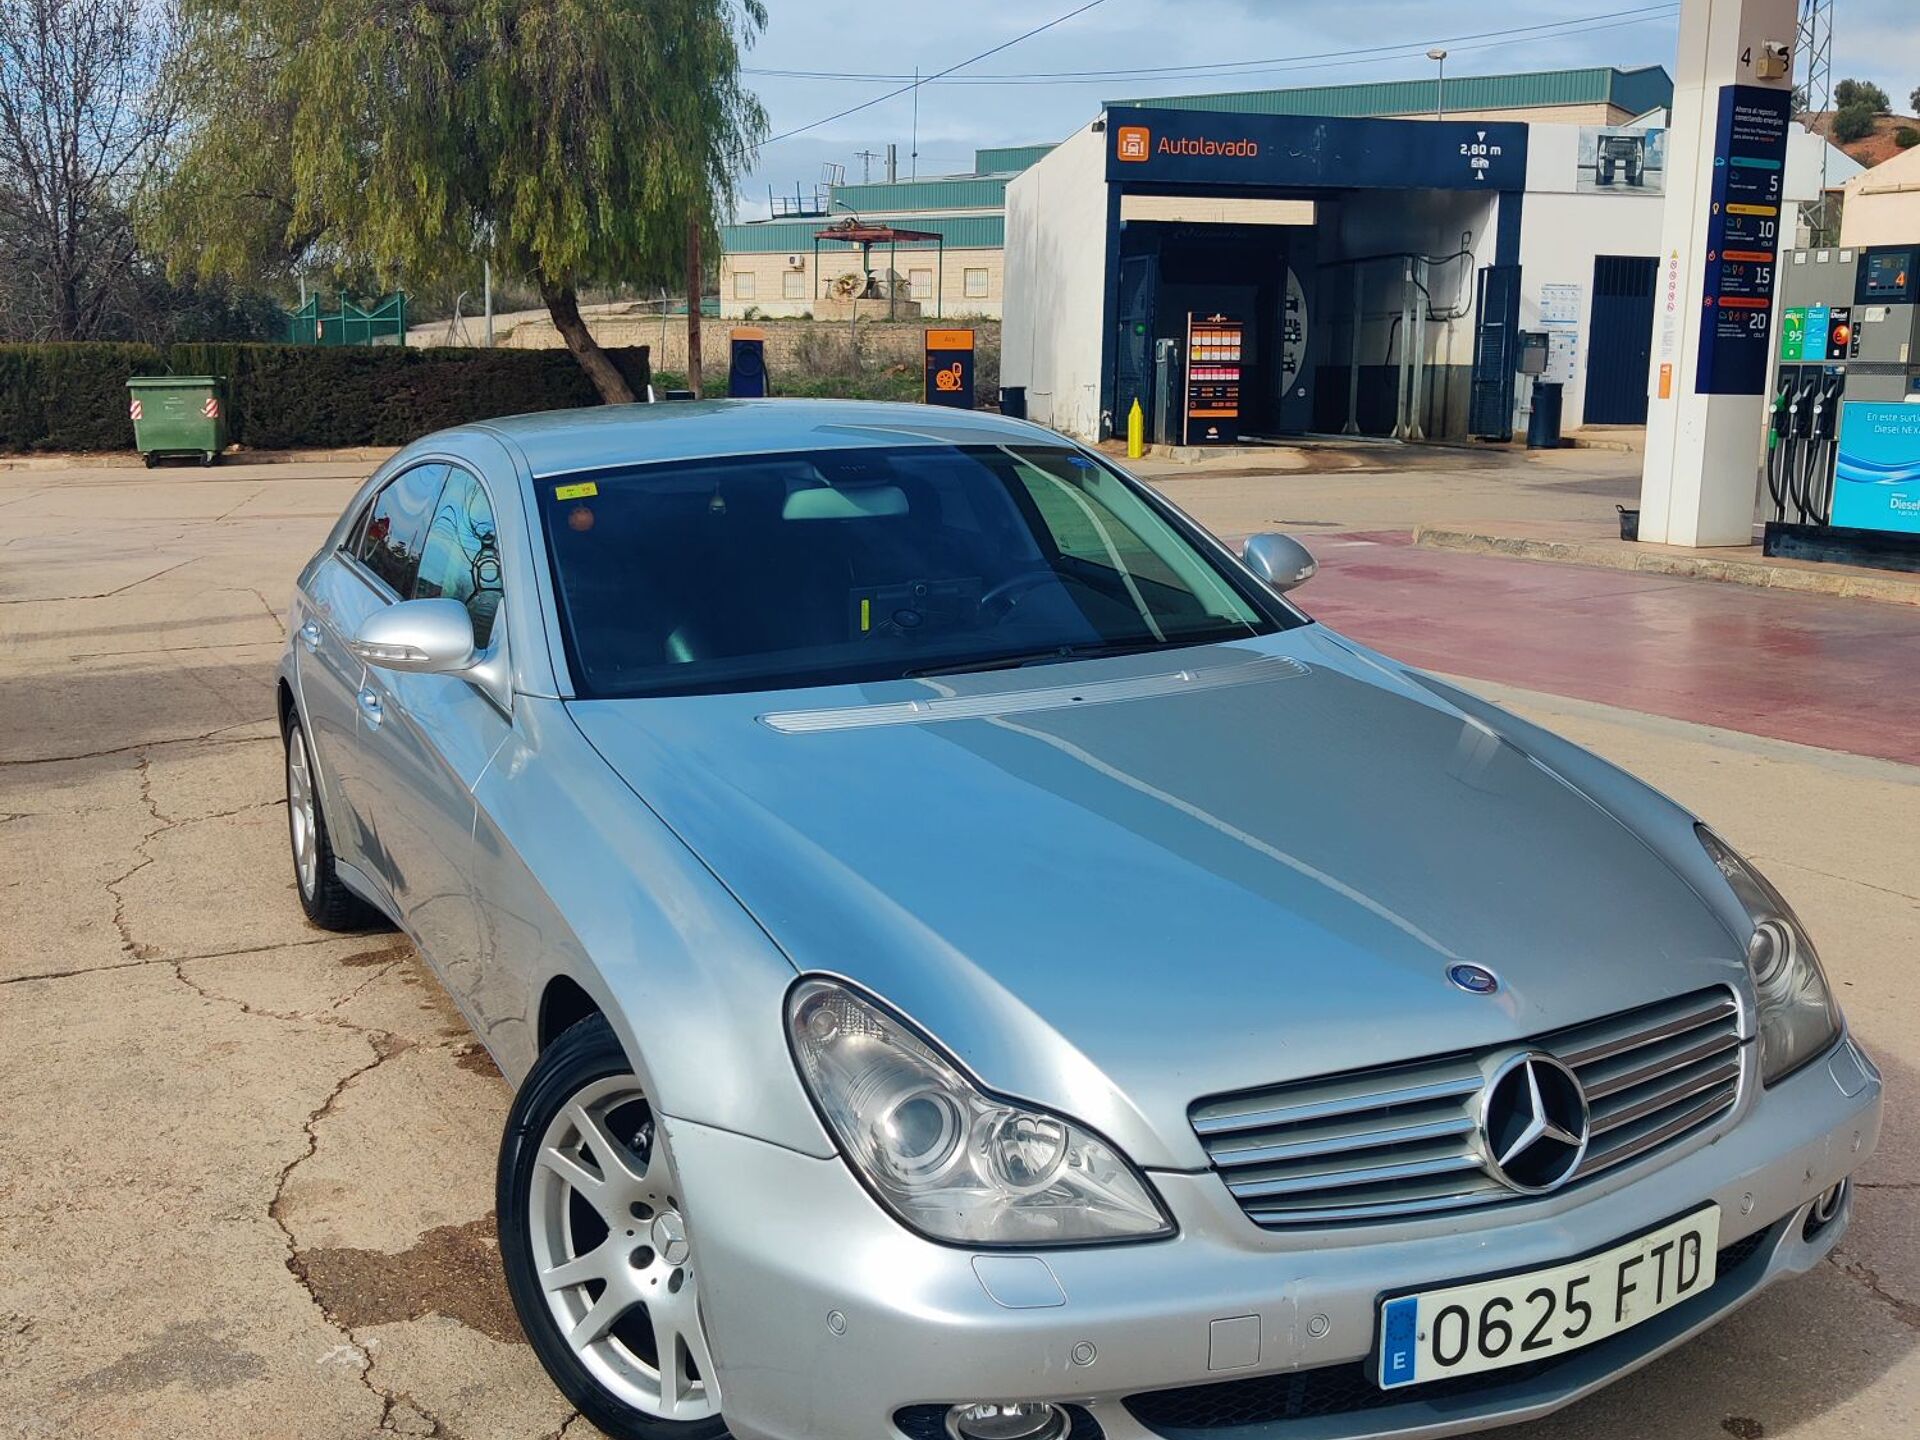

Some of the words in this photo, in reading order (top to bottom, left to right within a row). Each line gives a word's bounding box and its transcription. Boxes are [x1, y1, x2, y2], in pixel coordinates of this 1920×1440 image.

[1741, 47, 1751, 67] 4
[1158, 136, 1258, 157] Autolavado
[1460, 143, 1487, 156] 2,80
[1490, 146, 1501, 156] m
[1769, 175, 1779, 192] 5
[1759, 220, 1775, 238] 10
[1755, 267, 1771, 284] 15
[1895, 271, 1905, 286] 4
[1749, 313, 1767, 330] 20
[1788, 330, 1803, 342] 95
[1432, 1276, 1592, 1367] 0625
[1615, 1230, 1702, 1323] FTD
[1393, 1351, 1406, 1371] E
